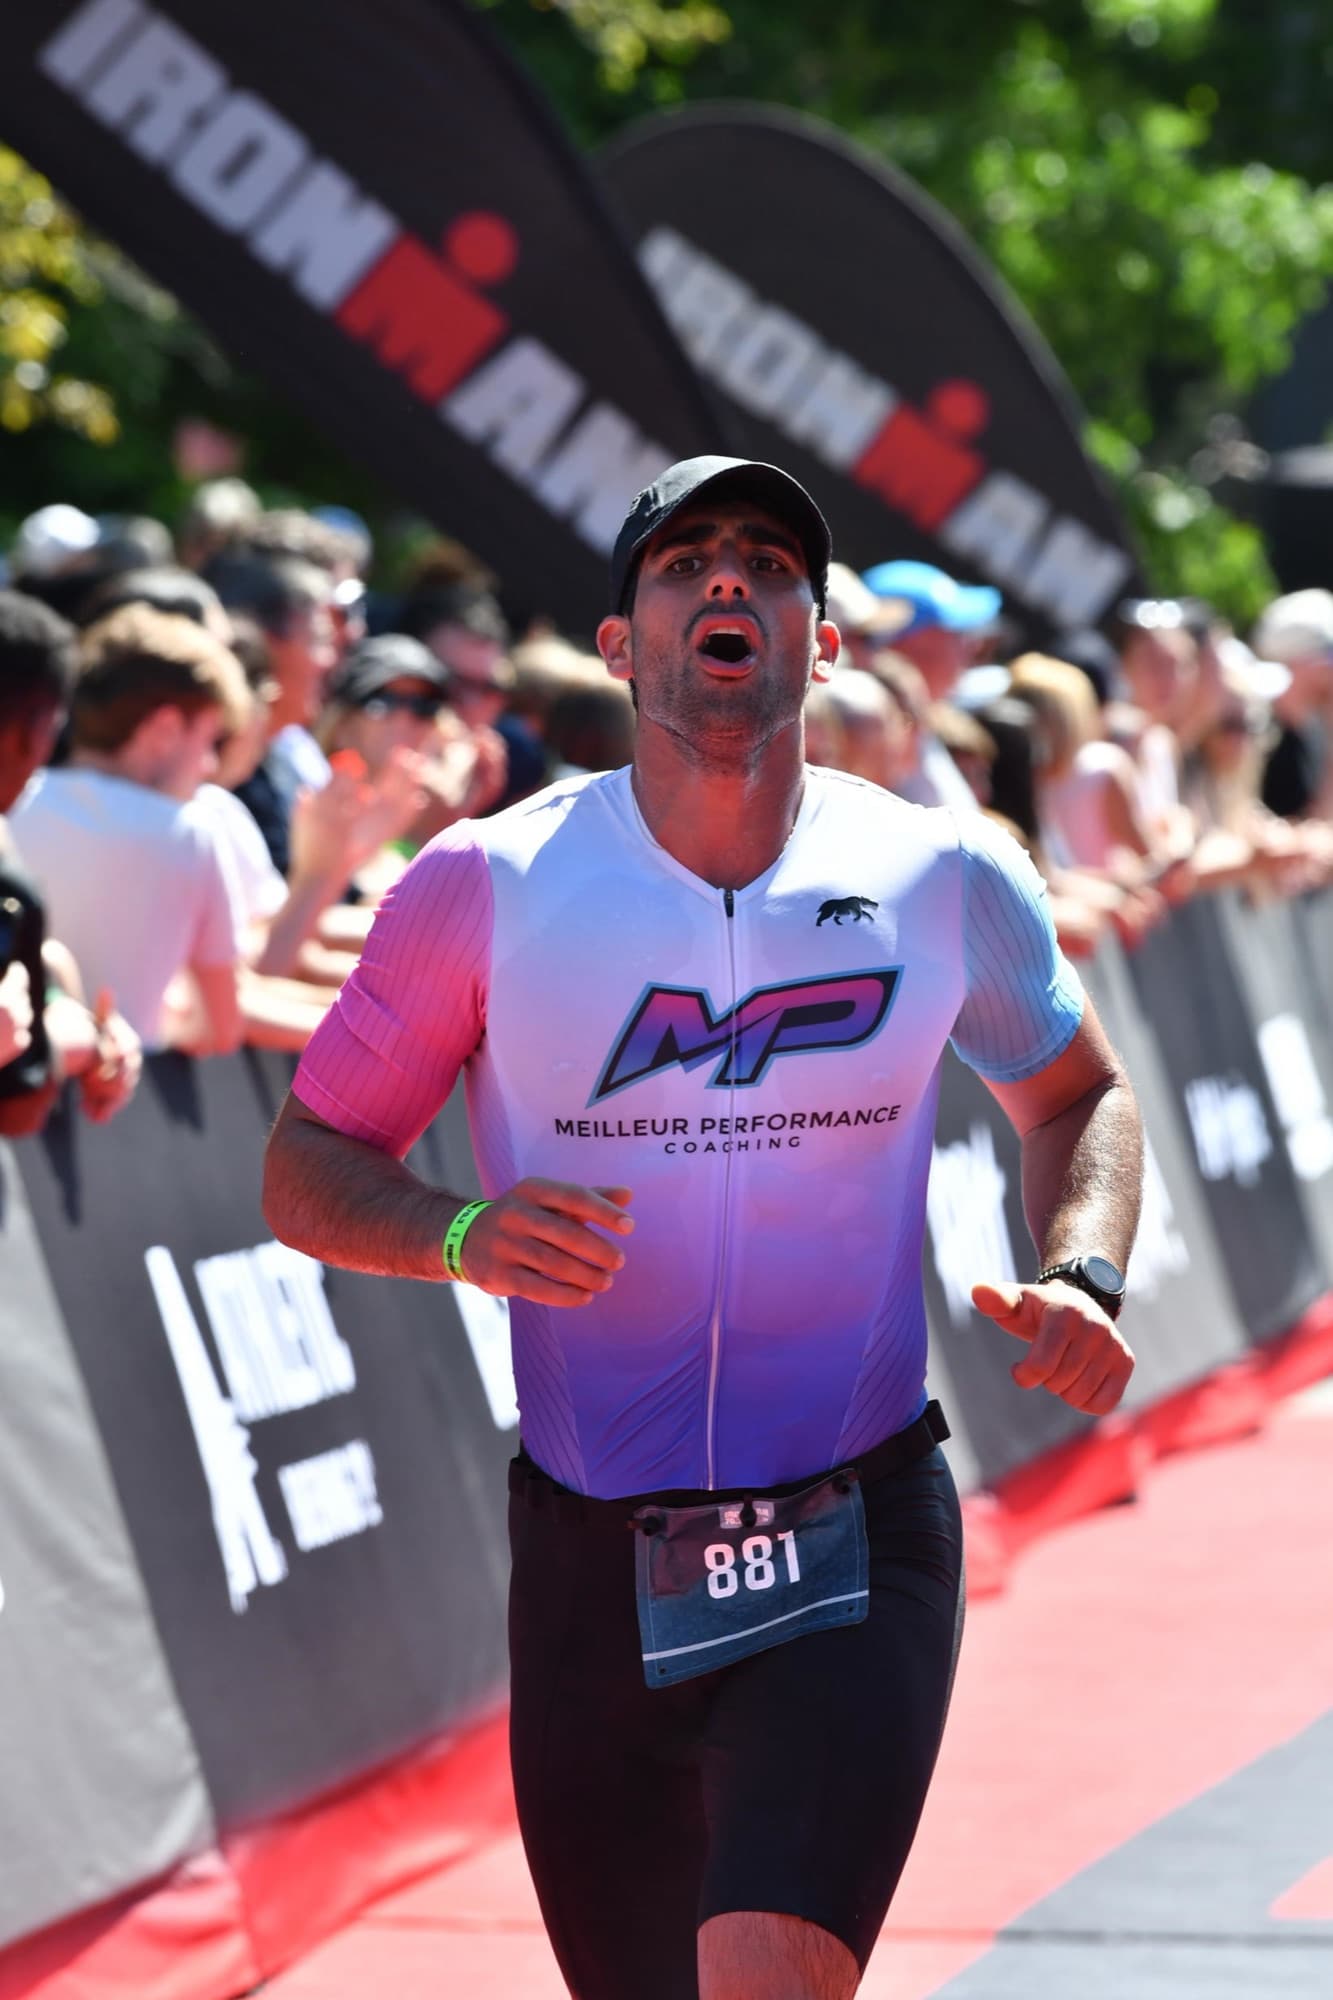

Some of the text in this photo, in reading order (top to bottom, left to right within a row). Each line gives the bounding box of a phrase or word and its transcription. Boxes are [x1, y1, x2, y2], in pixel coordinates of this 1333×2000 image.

[38, 0, 680, 558] IRONMAN
[585, 964, 905, 1109] MP
[554, 1104, 901, 1138] MEILLEUR PERFORMANCE
[664, 1136, 801, 1154] COACHING
[703, 1530, 800, 1599] 881
